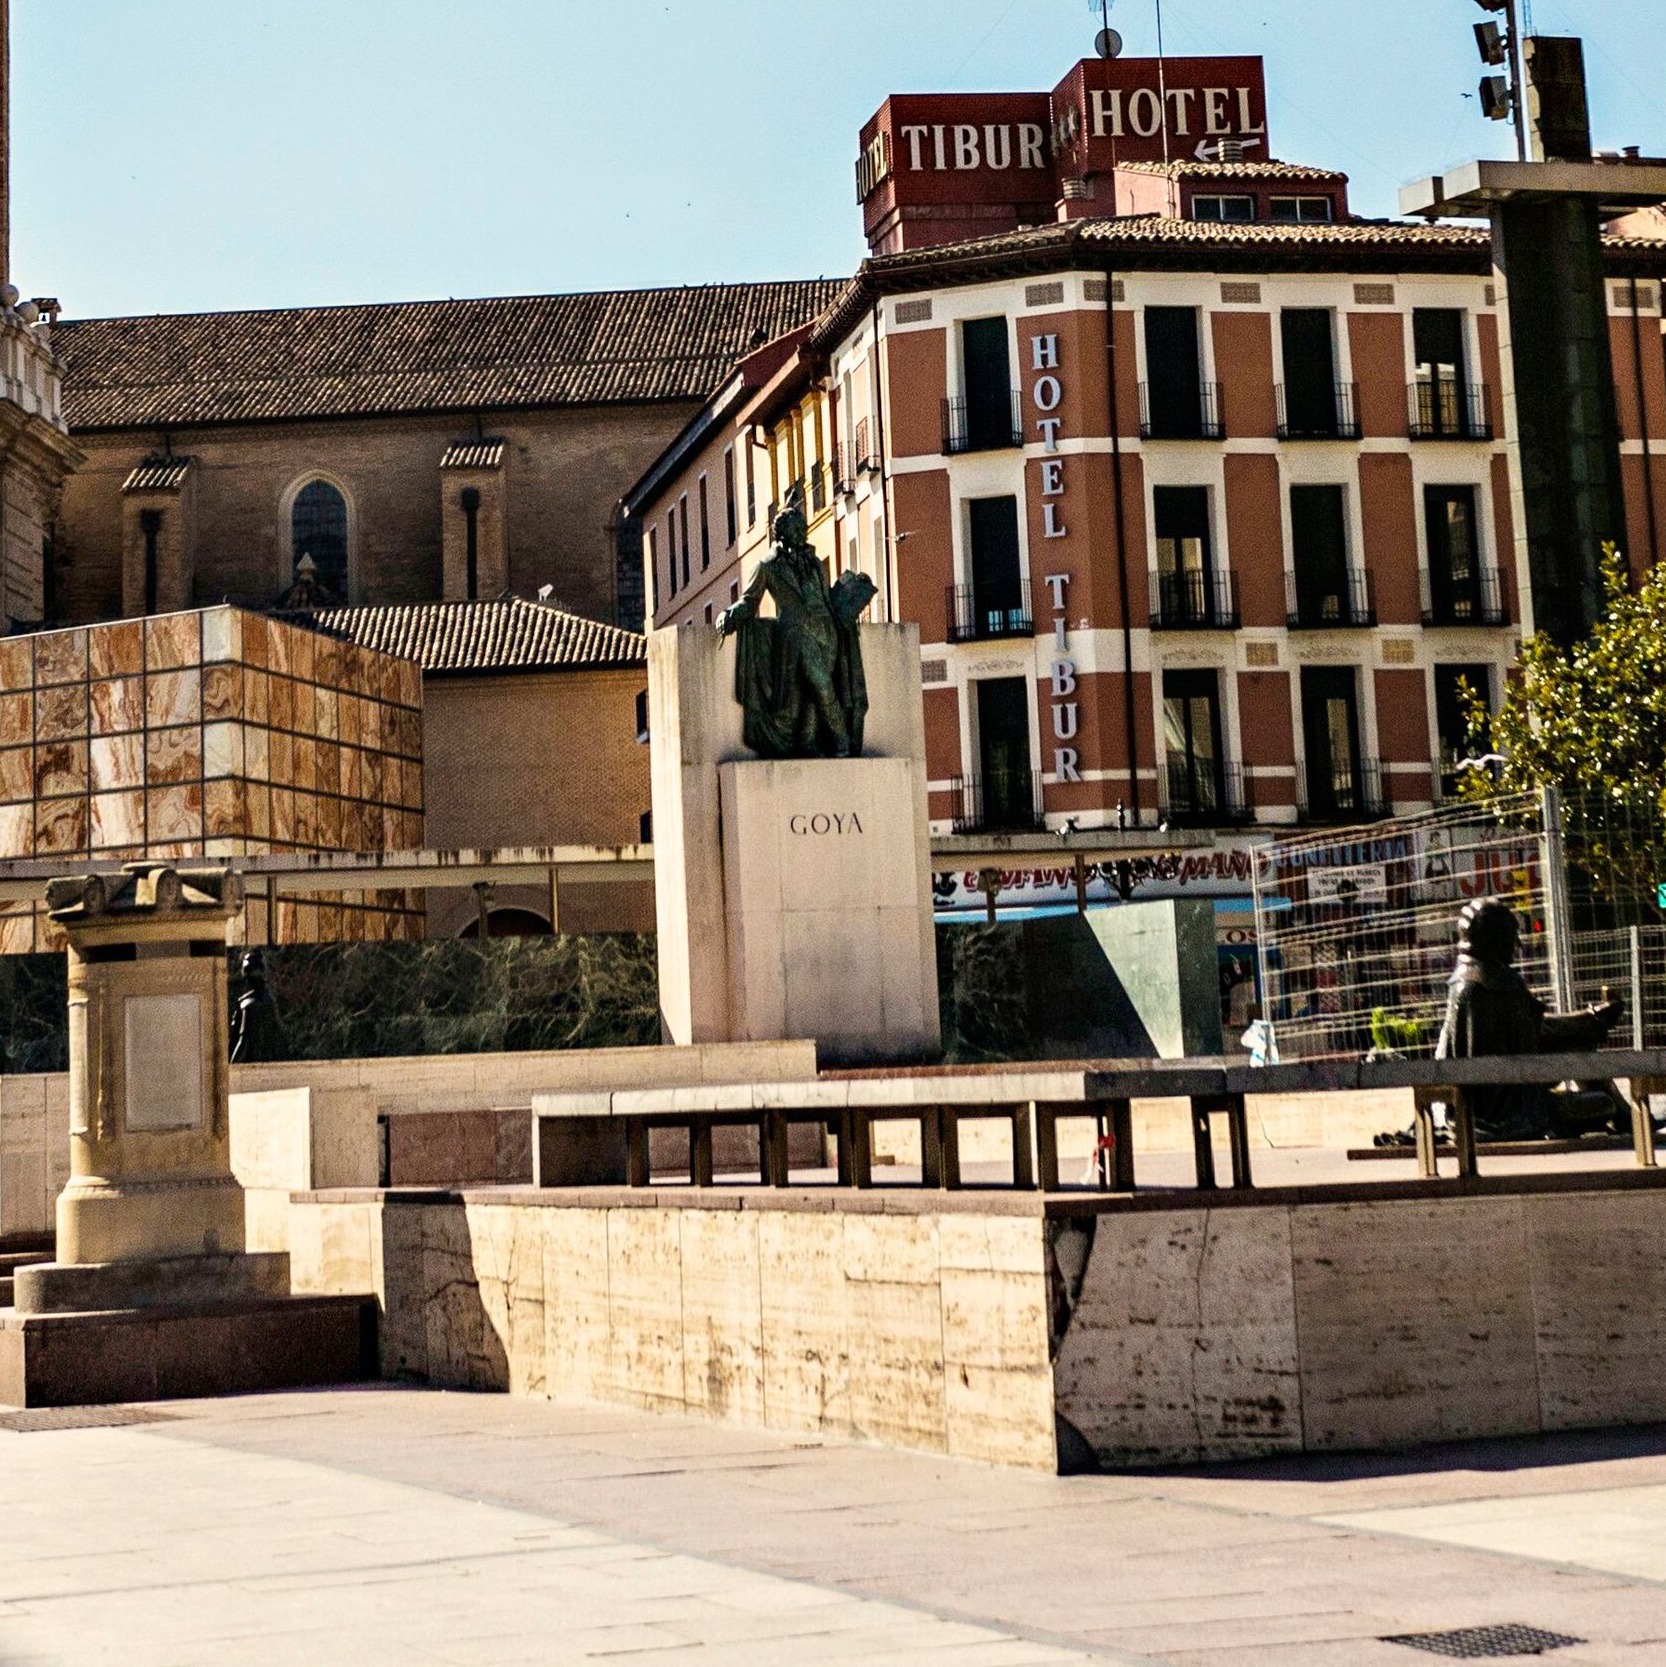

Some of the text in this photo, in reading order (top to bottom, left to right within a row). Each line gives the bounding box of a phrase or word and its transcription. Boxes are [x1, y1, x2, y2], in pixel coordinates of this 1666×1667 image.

[1090, 87, 1265, 138] HOTEL
[855, 130, 887, 205] HOTEL
[901, 123, 1045, 171] TIBUR
[1030, 333, 1083, 786] HOTEL TIBUR
[789, 812, 864, 835] GOYA
